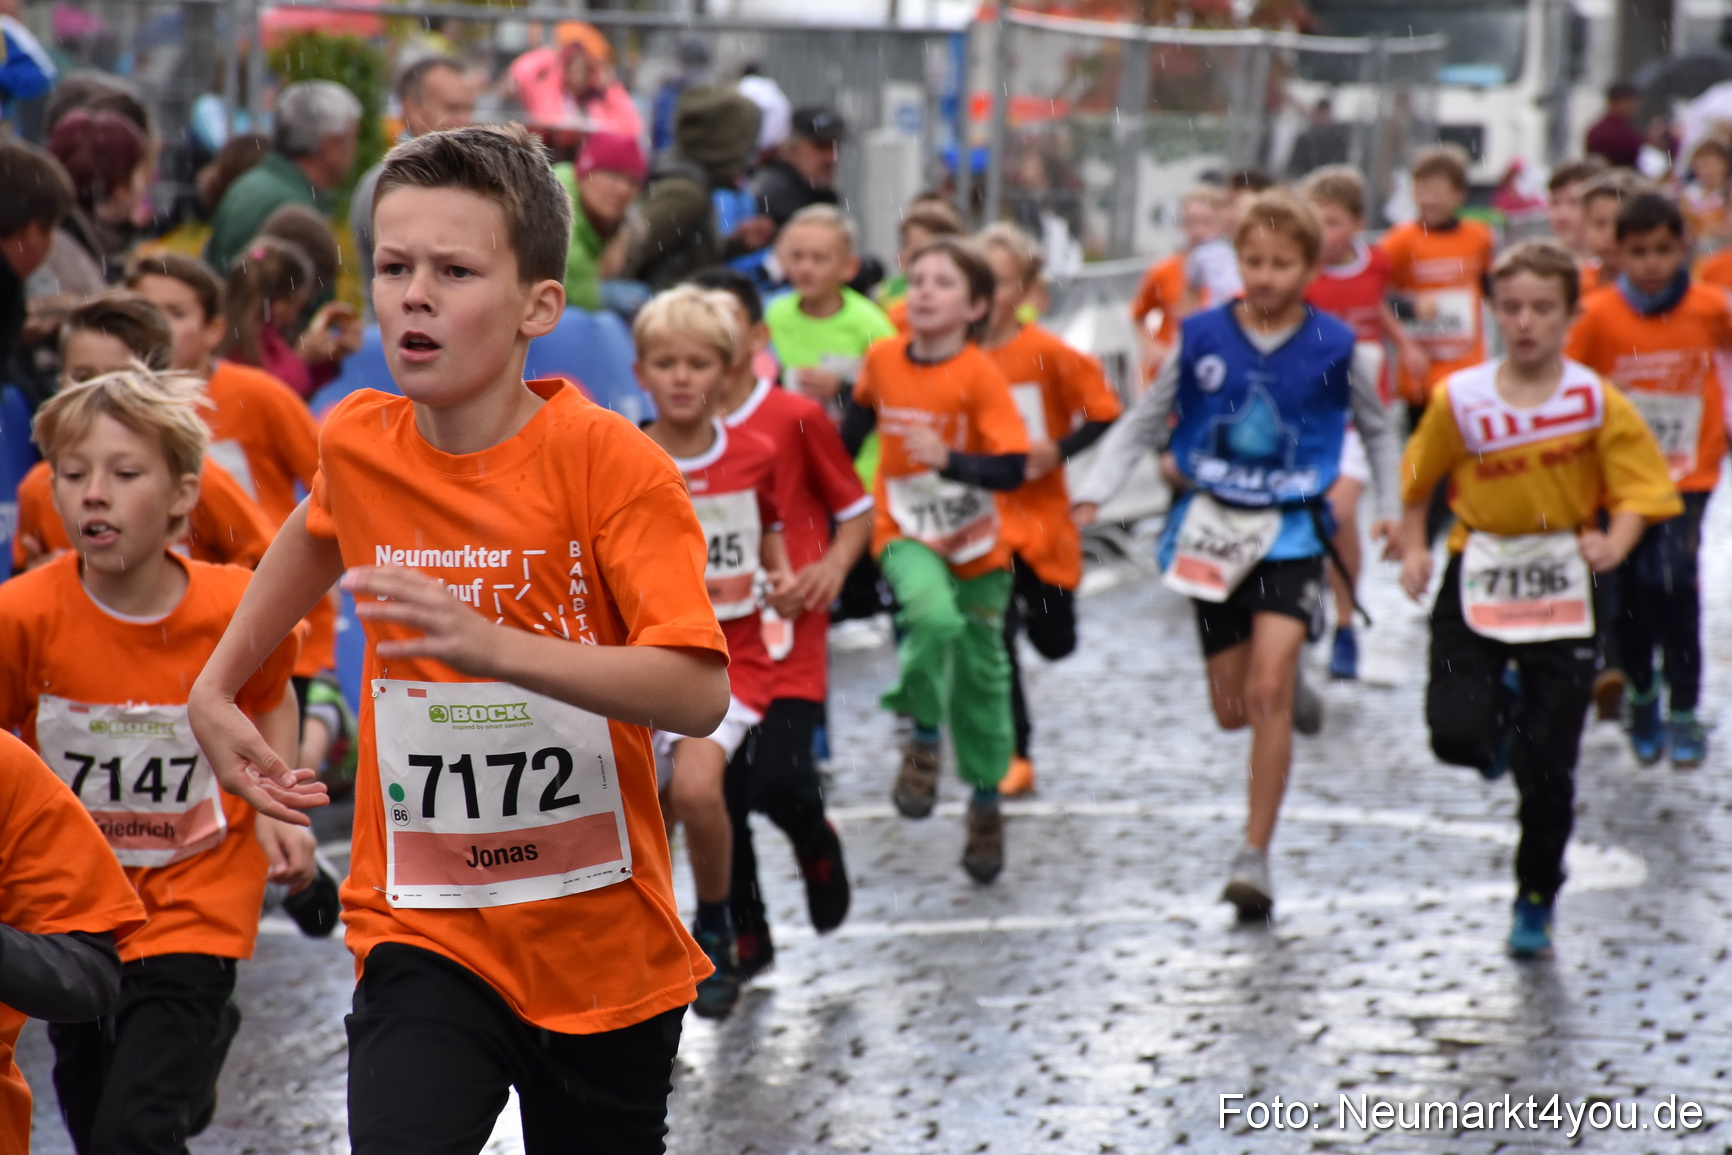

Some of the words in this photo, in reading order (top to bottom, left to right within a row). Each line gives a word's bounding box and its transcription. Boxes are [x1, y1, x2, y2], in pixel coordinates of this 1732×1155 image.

[375, 544, 512, 568] Neumarkter
[707, 532, 744, 568] 45
[1481, 562, 1570, 598] 7196
[450, 702, 531, 723] BOCK
[109, 720, 176, 739] BOCK
[452, 723, 476, 732] inspired
[476, 723, 484, 731] by
[504, 721, 534, 729] concepts
[64, 751, 199, 804] 7147
[407, 746, 581, 819] 7172
[393, 808, 408, 822] B6
[94, 818, 176, 840] riedrich
[466, 842, 539, 869] Jonas
